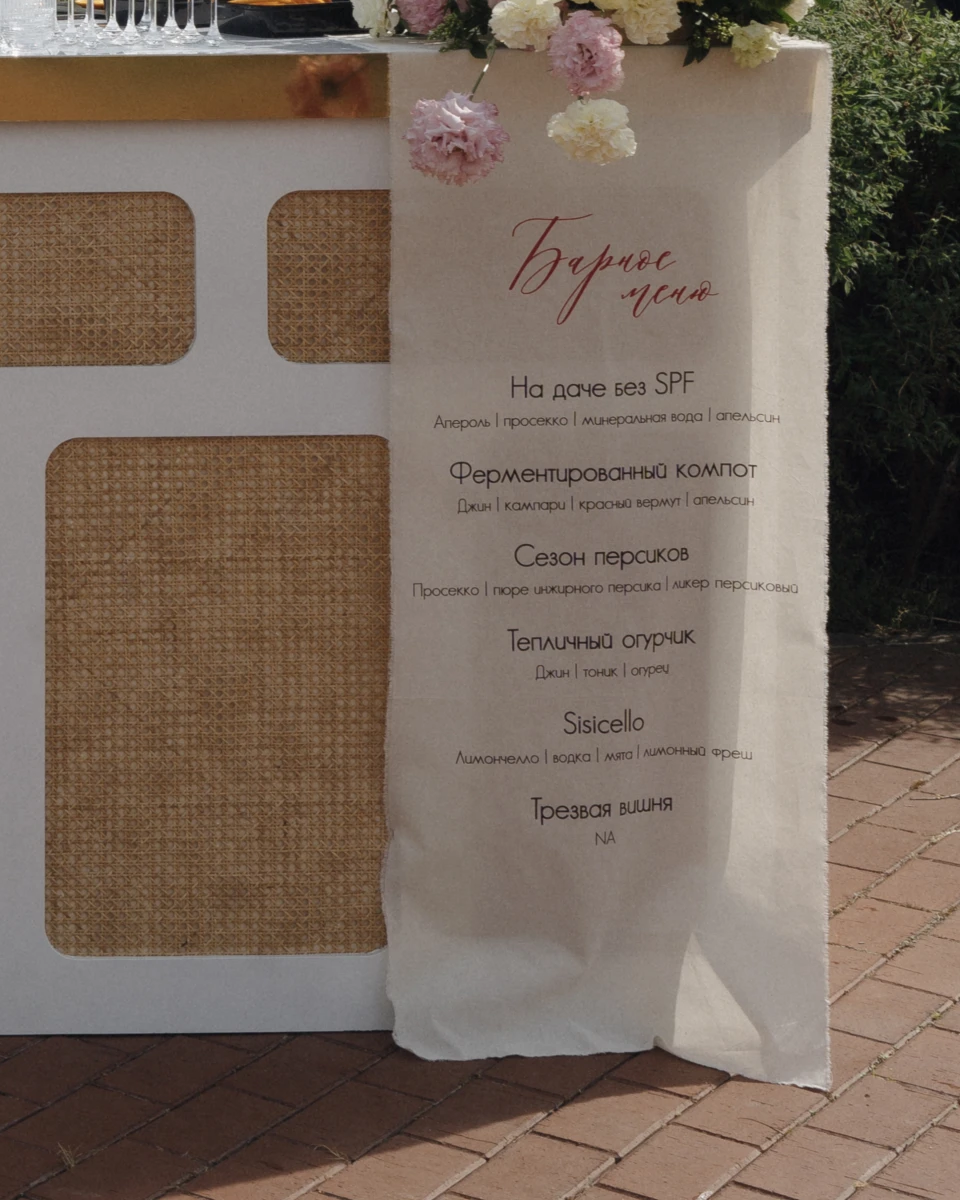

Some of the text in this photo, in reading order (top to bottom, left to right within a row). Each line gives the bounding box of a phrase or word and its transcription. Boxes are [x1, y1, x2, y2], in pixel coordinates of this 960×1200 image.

[508, 213, 679, 326] Барное
[620, 279, 720, 319] меню
[511, 370, 695, 402] На даче без SPF
[433, 411, 781, 432] Апероль просекко минеральная вода апельсин
[449, 460, 758, 490] Ферментированный компот
[456, 496, 755, 515] Джин кампари красный вермут апельсин
[513, 543, 690, 571] Сезон персиков
[412, 578, 799, 601] Просекко пюре инжирного персика ликер персиковый
[506, 628, 697, 653] Тепличный огурчик
[534, 663, 670, 681] Джин тоник огурец
[563, 707, 645, 736] Sisicello
[455, 745, 753, 765] Лимончелло водка мята лимонный фреш
[529, 796, 673, 826] Трезвая вишня
[594, 830, 617, 846] NA
